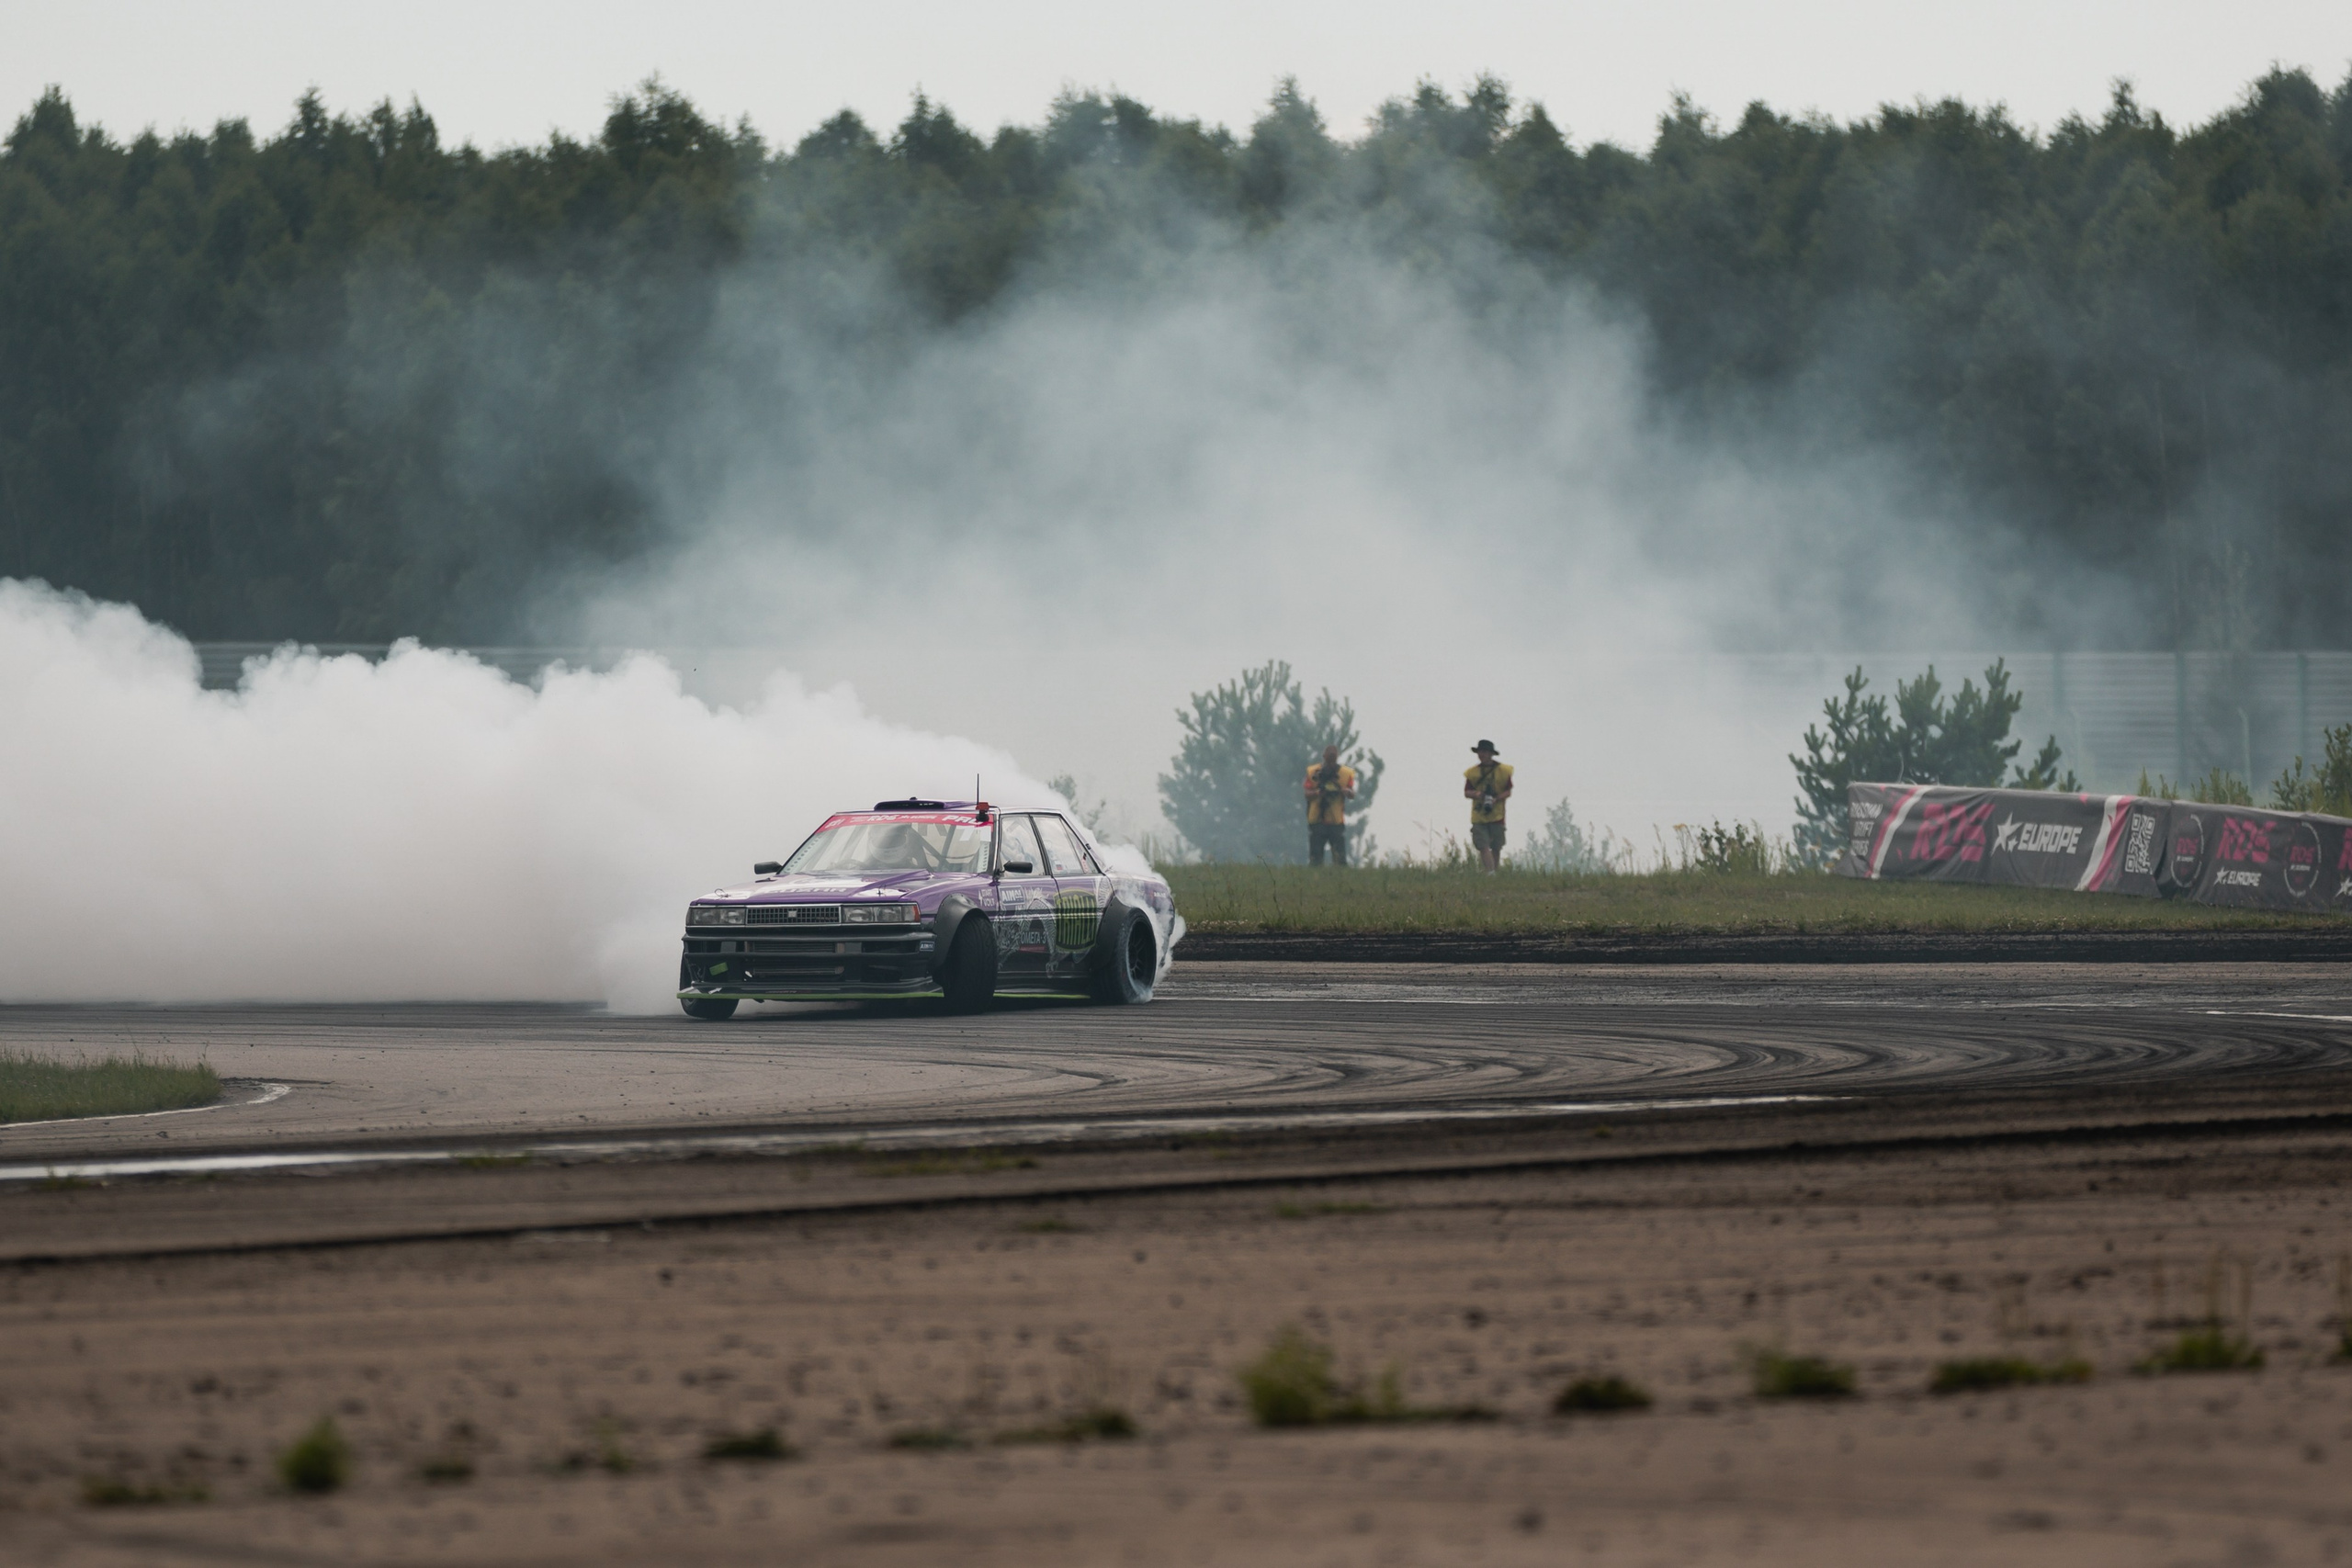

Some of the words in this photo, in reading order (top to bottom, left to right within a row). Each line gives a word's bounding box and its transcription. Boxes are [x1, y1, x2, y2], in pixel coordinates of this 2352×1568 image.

[1909, 803, 1996, 862] RDS
[2018, 823, 2083, 854] EUROPE
[2216, 817, 2278, 863] RDS
[2227, 870, 2262, 887] EUROPE
